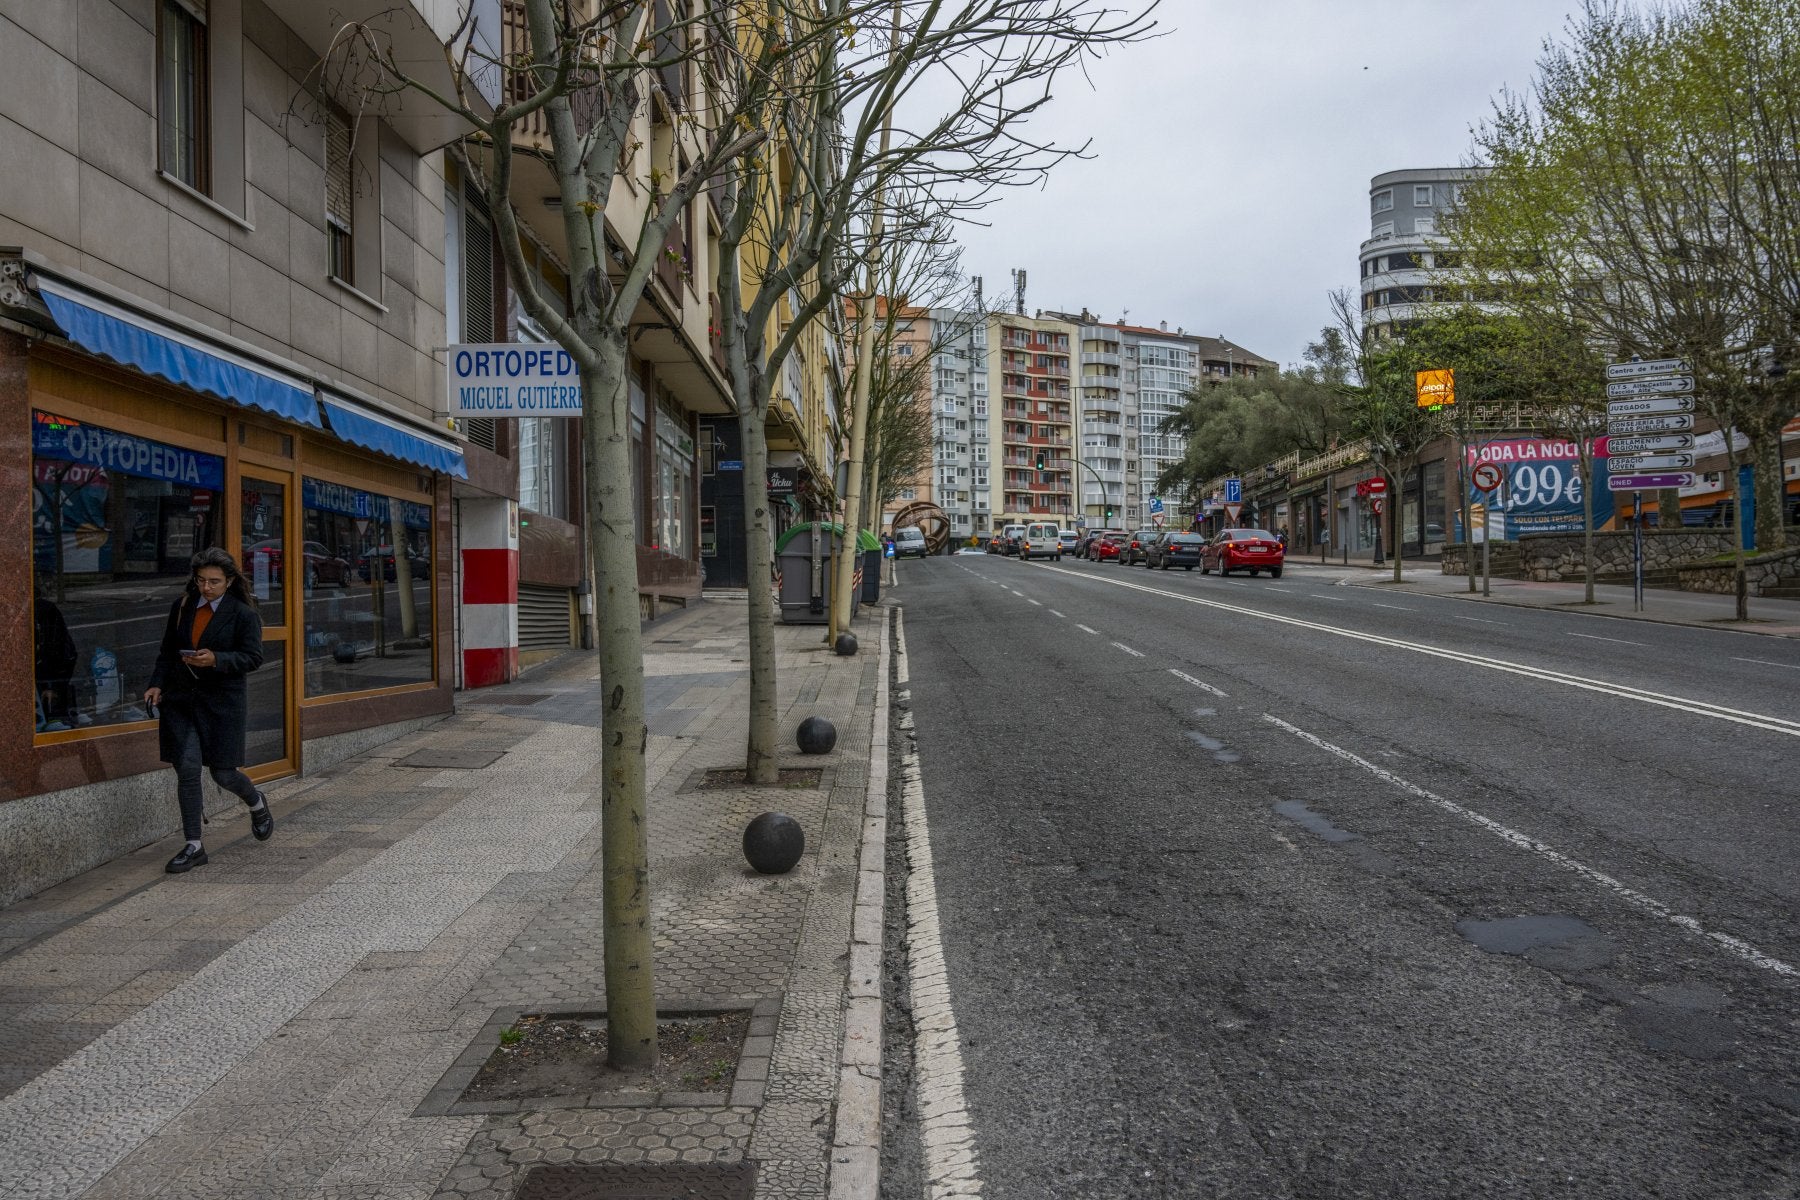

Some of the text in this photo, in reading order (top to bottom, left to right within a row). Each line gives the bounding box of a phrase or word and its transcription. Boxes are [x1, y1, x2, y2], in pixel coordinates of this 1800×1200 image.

[460, 387, 512, 409] MIGUEL
[1610, 426, 1633, 434] OBRAS
[1611, 438, 1661, 446] PARLAMENTO
[67, 426, 200, 484] ORTOPEDIA
[1518, 443, 1536, 459] LA
[1611, 457, 1643, 465] ESPACIO
[1514, 515, 1532, 524] SOLO
[1534, 515, 1549, 523] CON
